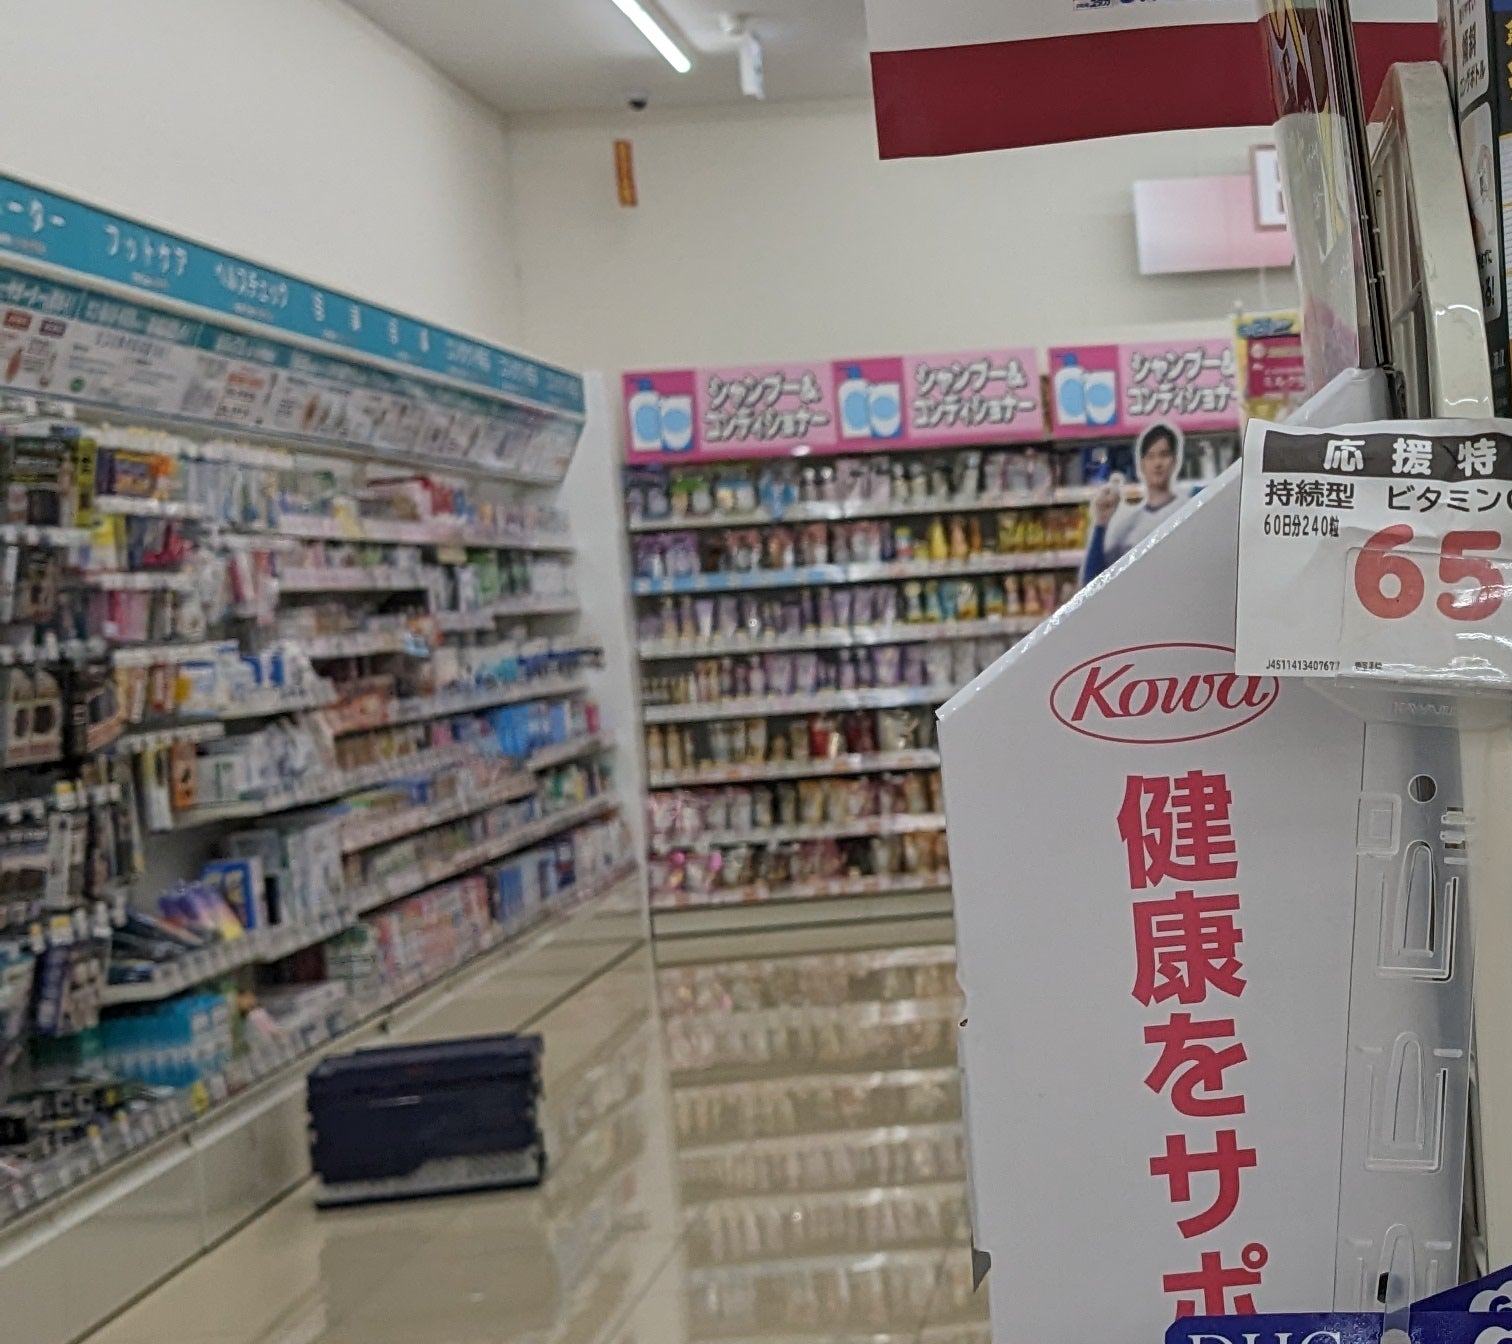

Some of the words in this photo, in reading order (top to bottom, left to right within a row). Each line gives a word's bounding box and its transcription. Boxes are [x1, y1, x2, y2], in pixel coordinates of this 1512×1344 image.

[1264, 480, 1355, 509] 持続型
[1264, 515, 1339, 538] 60日分240粒
